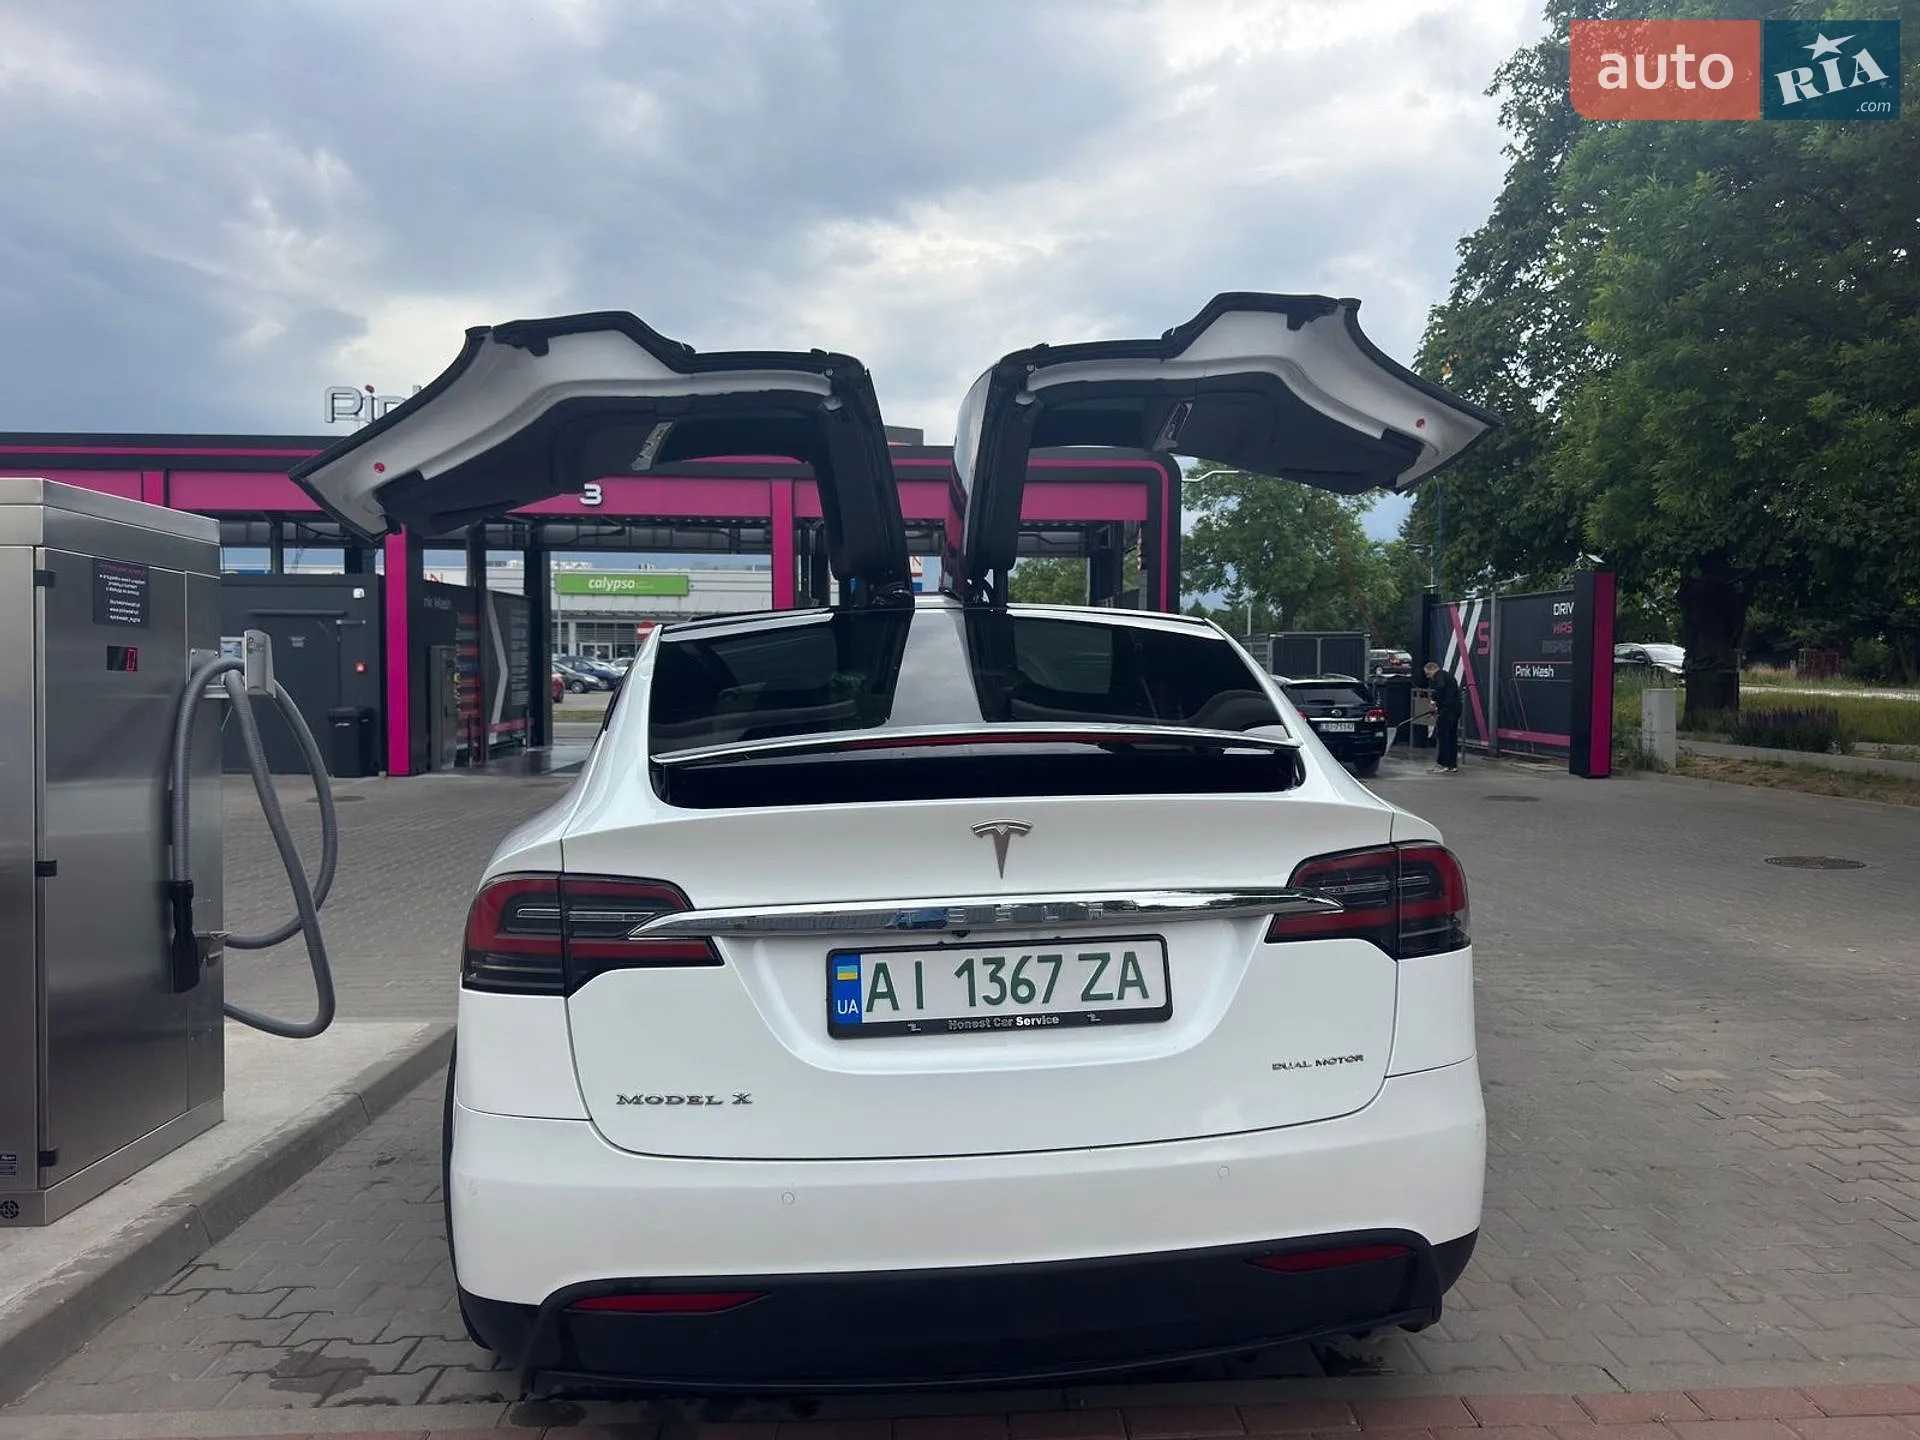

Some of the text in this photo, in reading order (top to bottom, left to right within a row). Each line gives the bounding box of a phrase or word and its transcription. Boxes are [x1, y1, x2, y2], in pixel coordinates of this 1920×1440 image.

[579, 483, 602, 505] 3
[588, 576, 635, 592] calypso
[1515, 664, 1554, 677] Pink Wash
[953, 953, 1063, 1007] 1367
[1077, 951, 1149, 1001] ZA
[836, 999, 859, 1015] UA
[948, 1015, 1060, 1030] Honest Car Service
[1272, 1054, 1364, 1071] DUAL MOTOR
[616, 1093, 753, 1106] MODEL X
